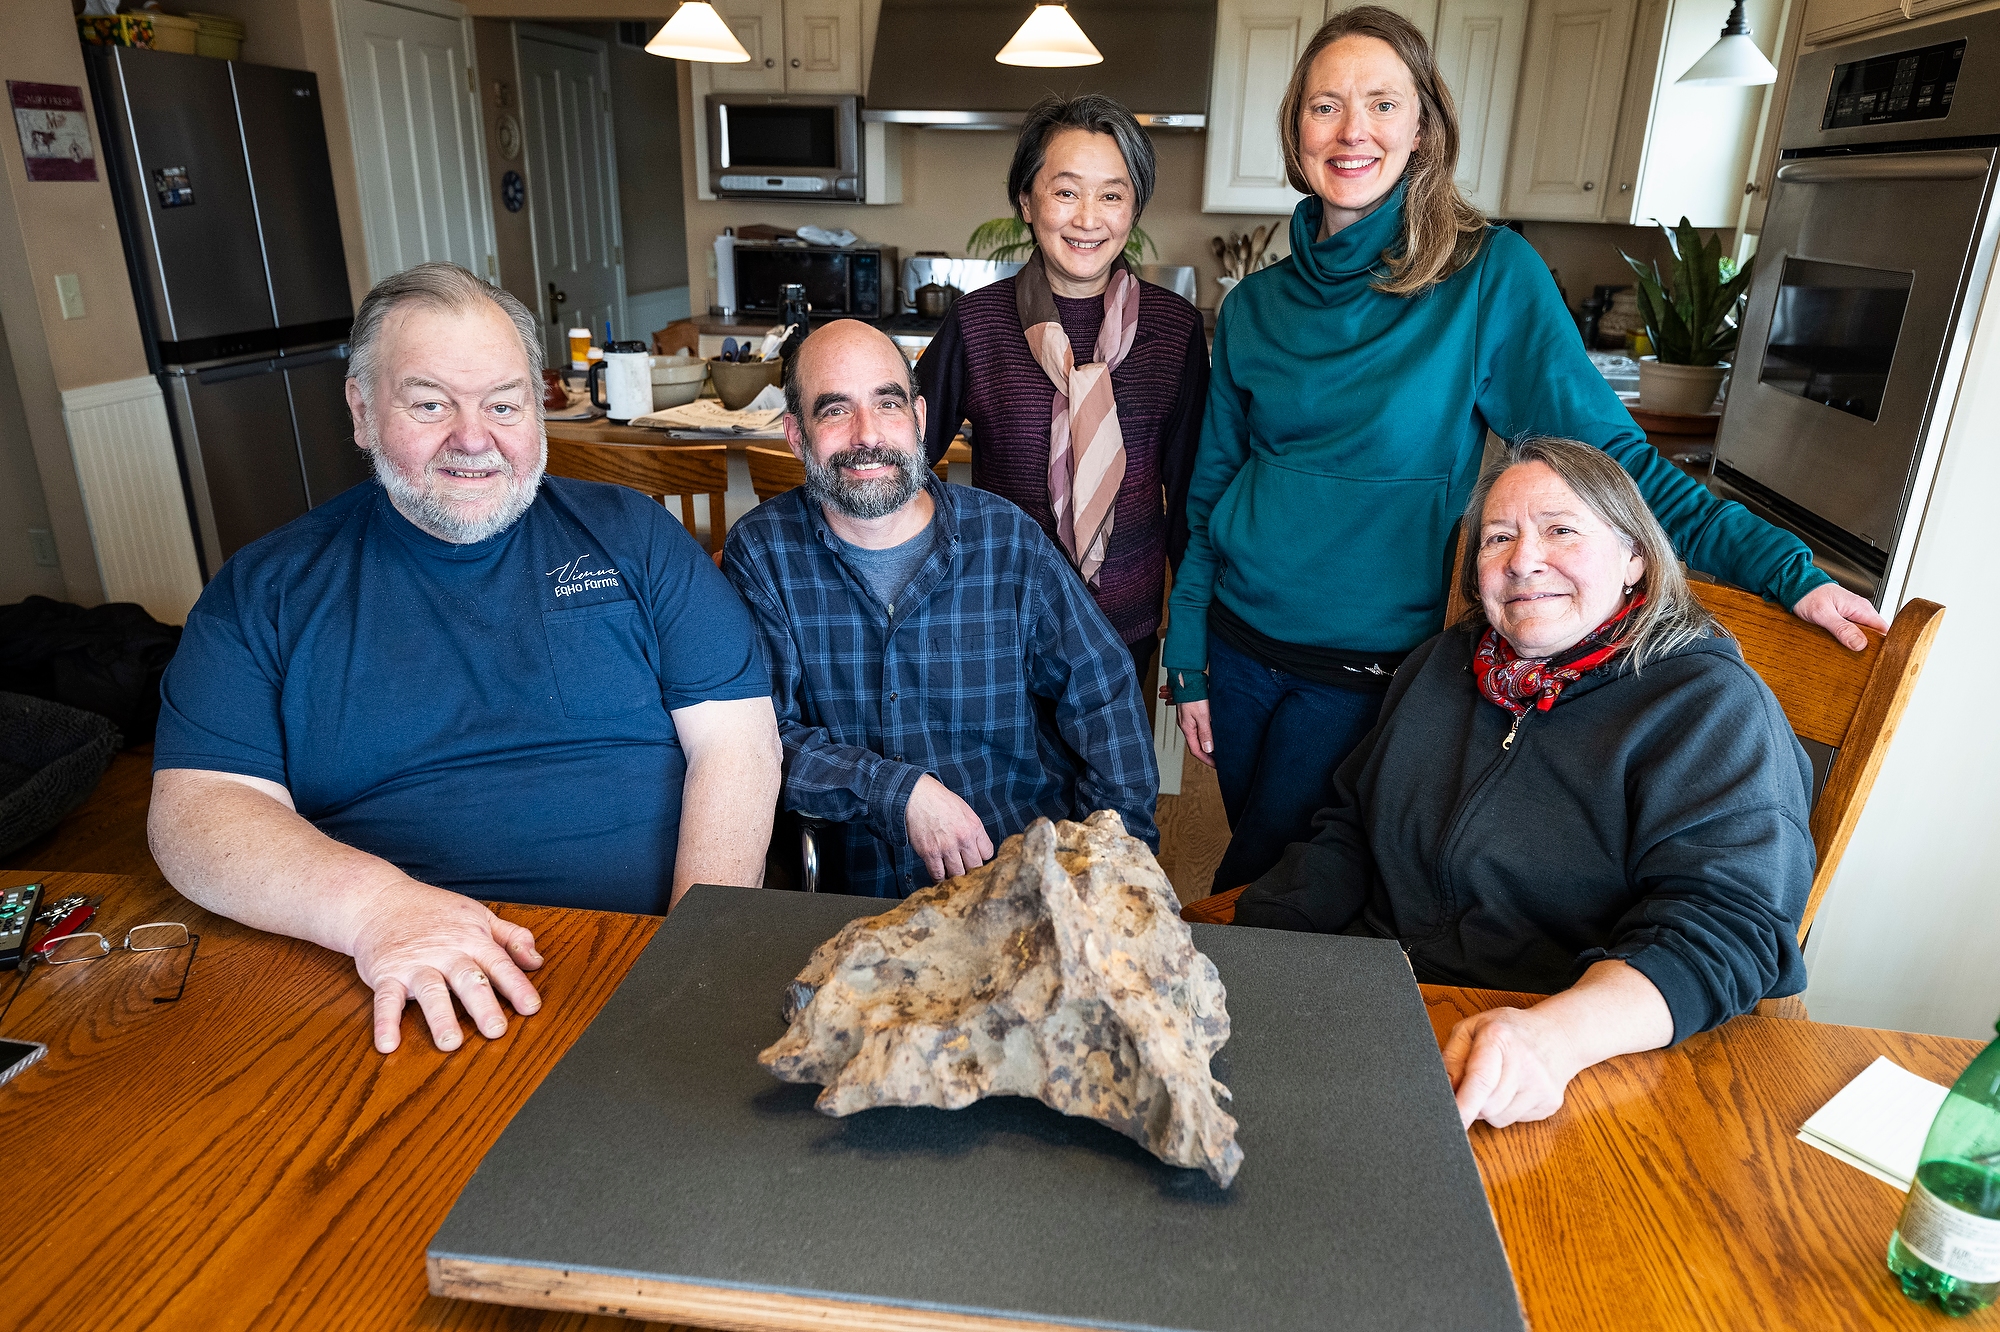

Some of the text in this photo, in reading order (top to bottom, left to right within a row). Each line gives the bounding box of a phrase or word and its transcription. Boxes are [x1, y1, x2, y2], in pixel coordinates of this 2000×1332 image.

[545, 553, 620, 584] Vienna
[554, 578, 619, 598] EqHo Farms
